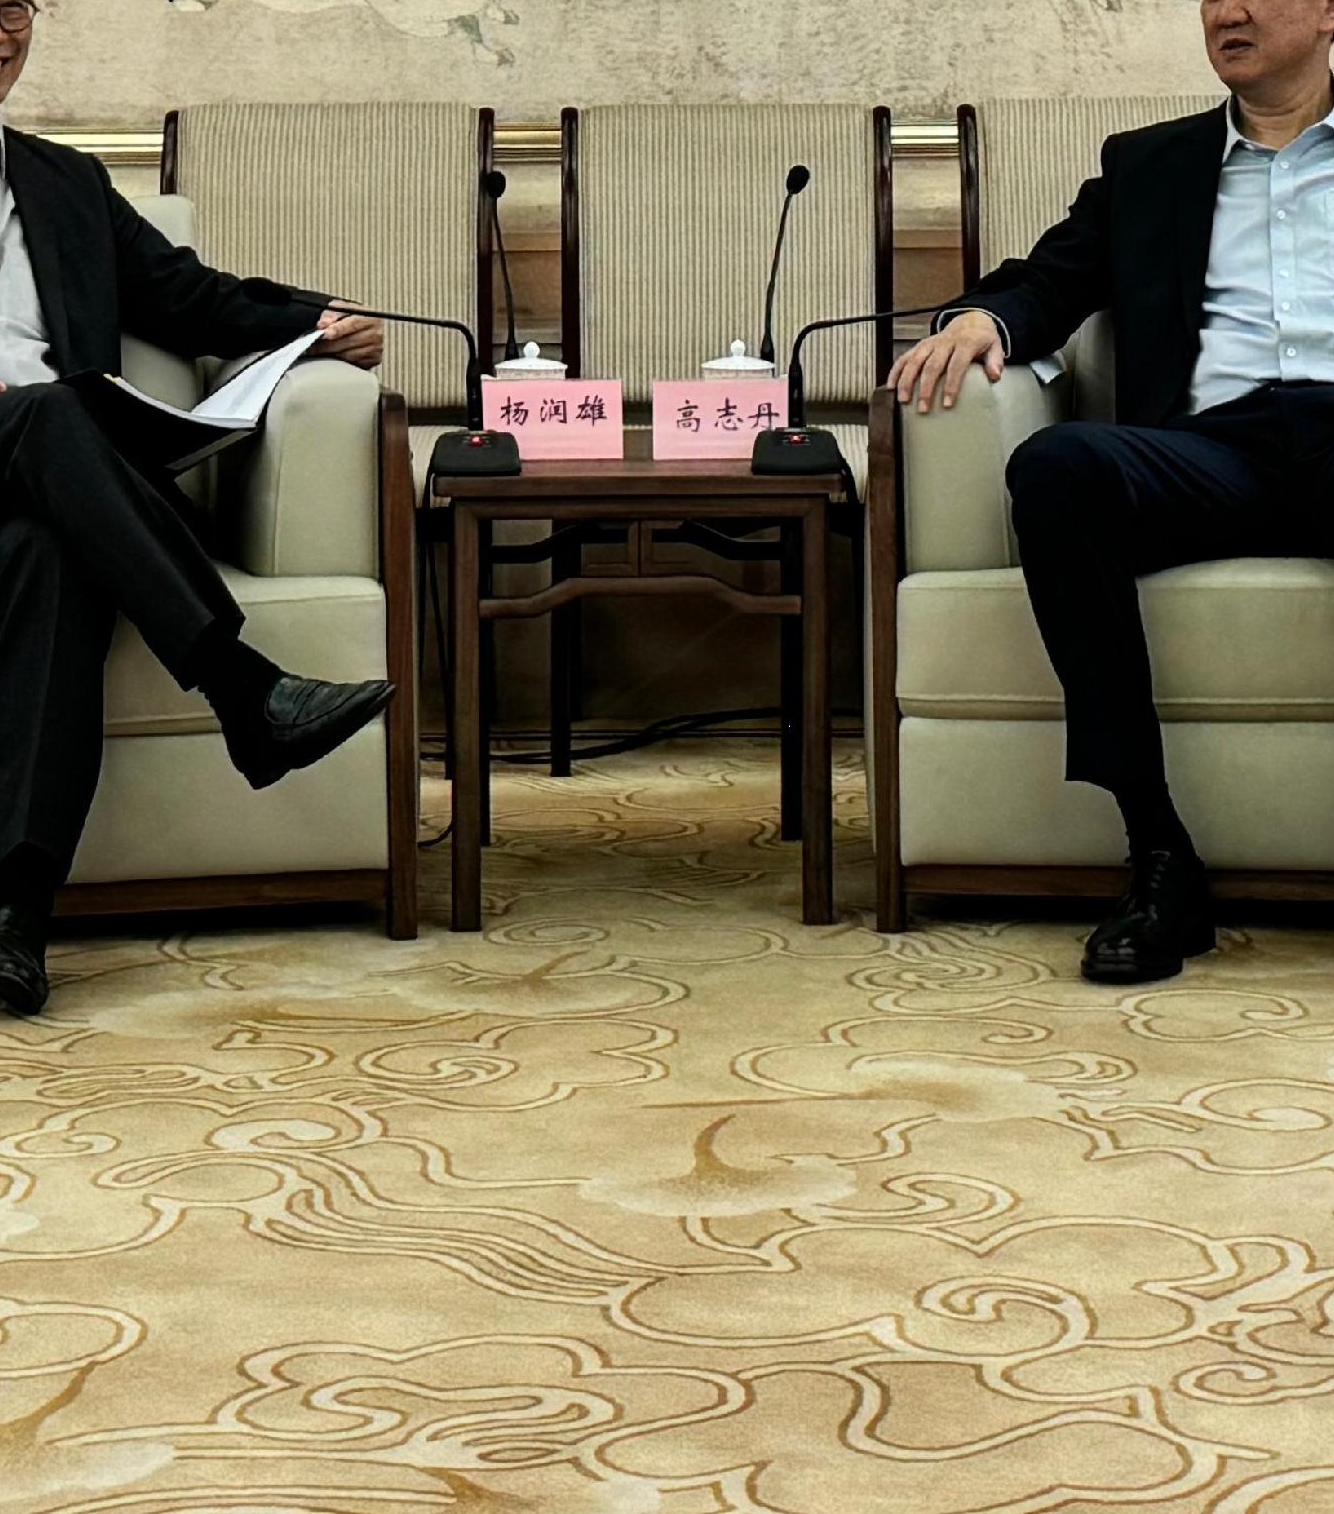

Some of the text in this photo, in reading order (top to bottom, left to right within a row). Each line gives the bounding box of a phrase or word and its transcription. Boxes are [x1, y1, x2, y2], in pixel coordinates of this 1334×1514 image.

[500, 394, 608, 427] 杨润雄
[676, 397, 780, 432] 高志丹
